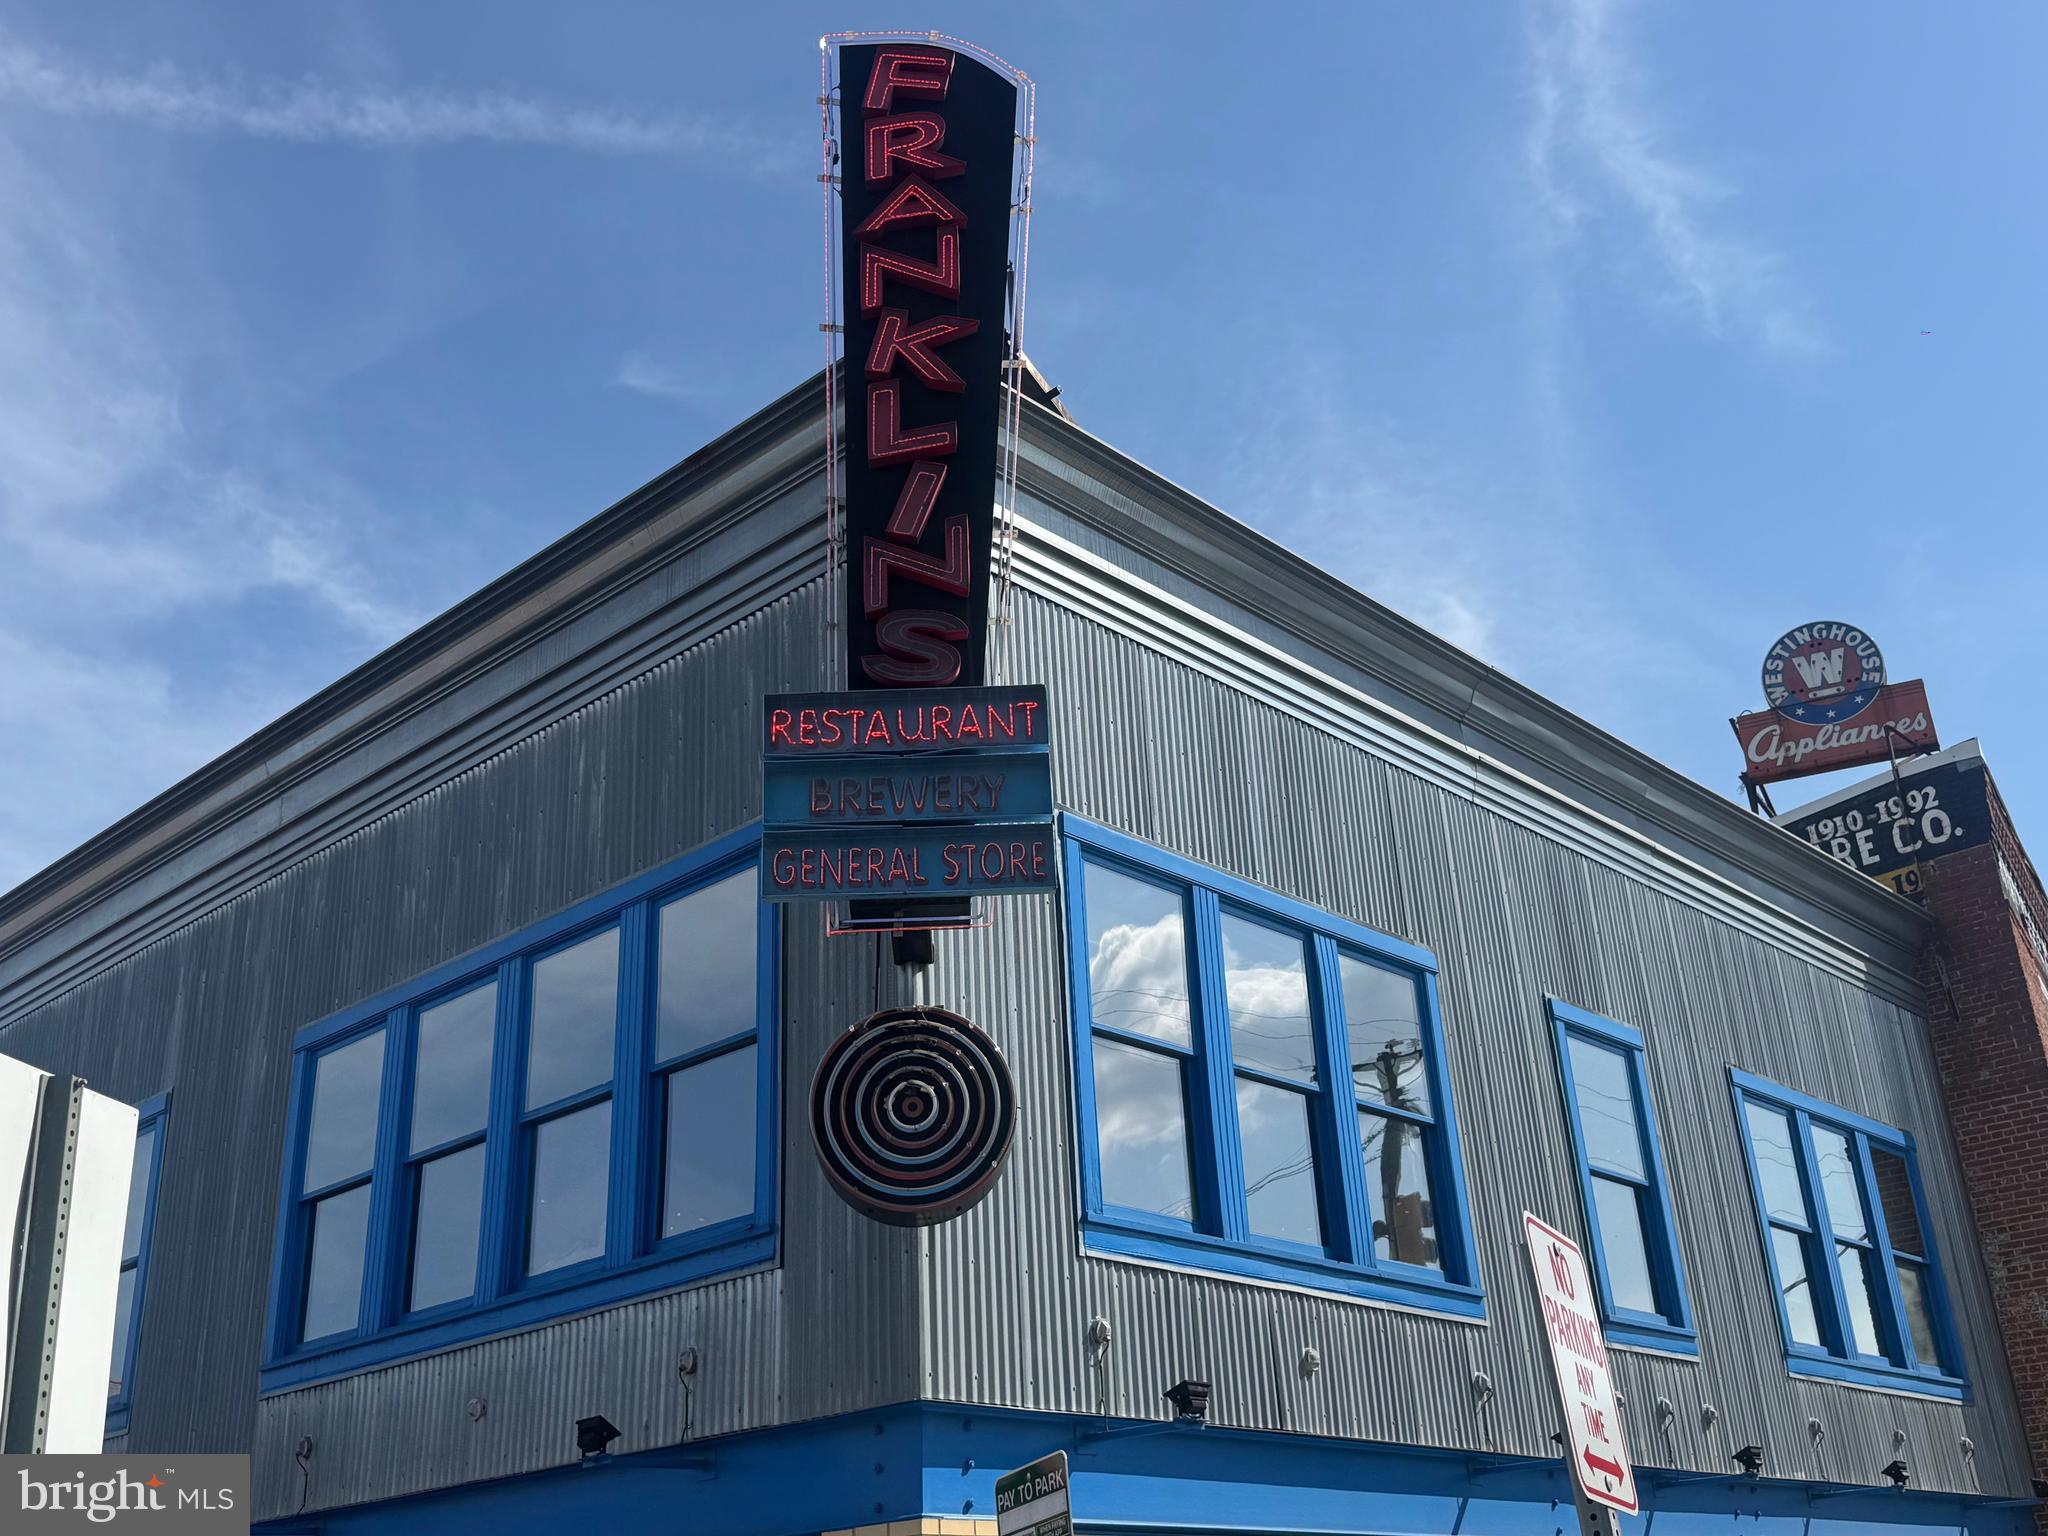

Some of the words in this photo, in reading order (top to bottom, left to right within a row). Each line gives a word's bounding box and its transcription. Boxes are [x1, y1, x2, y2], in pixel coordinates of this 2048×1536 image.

[854, 46, 980, 686] FRANKLINS
[1765, 624, 1881, 705] WESTINGHOUSE
[771, 702, 1038, 745] RESTAURANT
[809, 773, 1006, 816] BREWERY
[1812, 828, 1881, 869] RE
[1892, 808, 1964, 854] CO.
[772, 847, 926, 886] GENERAL
[943, 842, 1046, 881] STORE
[1547, 1244, 1576, 1301] NO
[1545, 1294, 1604, 1369] PARKING
[1575, 1361, 1598, 1401] ANY
[1580, 1401, 1610, 1445] TIME
[997, 1488, 1016, 1512] PAY
[1018, 1481, 1033, 1503] TO
[1035, 1468, 1065, 1497] PARK
